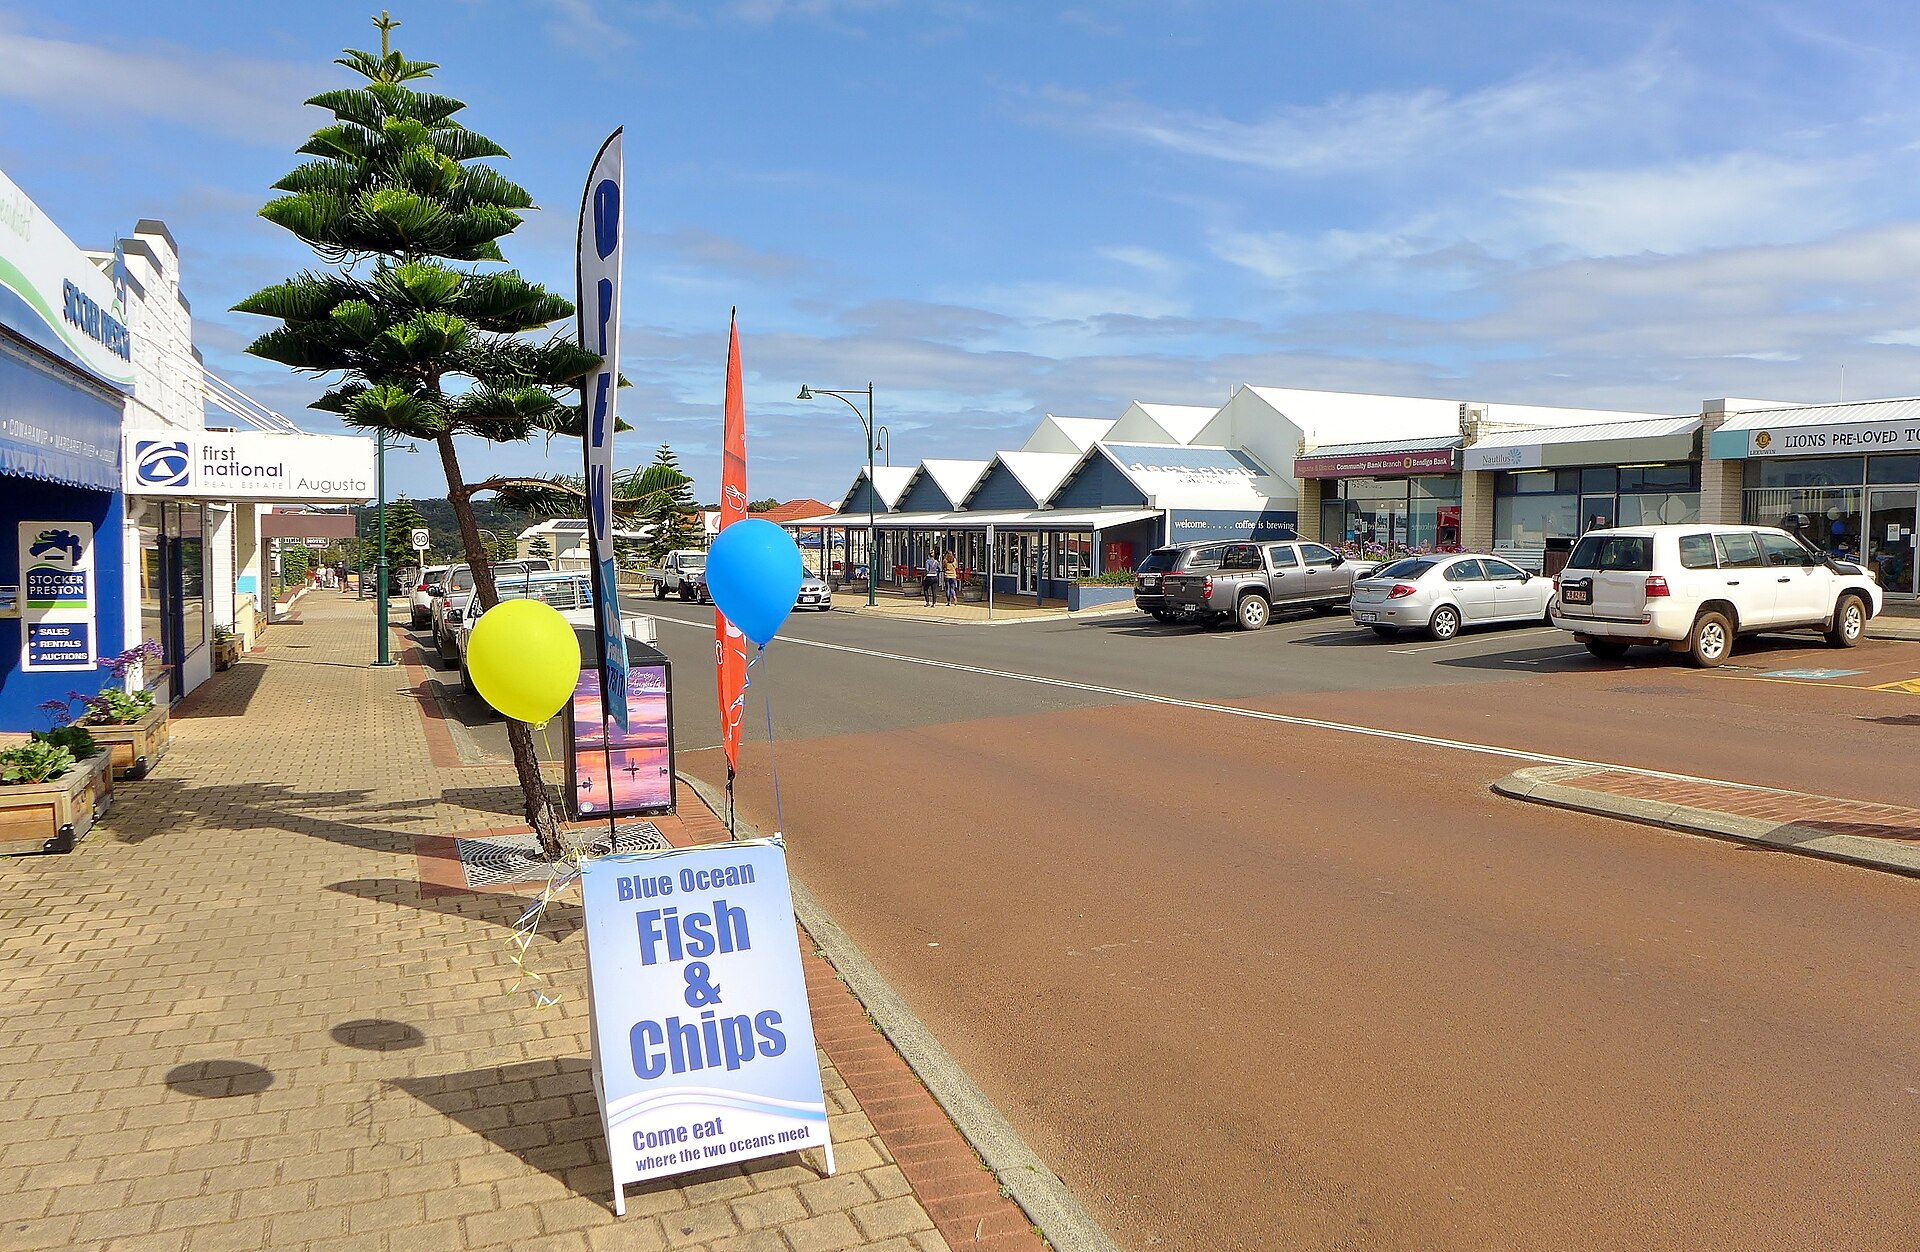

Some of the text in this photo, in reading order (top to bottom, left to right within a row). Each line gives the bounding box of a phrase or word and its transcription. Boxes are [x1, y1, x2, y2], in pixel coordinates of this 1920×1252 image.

[591, 178, 620, 541] OPEN
[1784, 434, 1826, 448] LIONS
[1832, 430, 1898, 446] PRE-LOVED
[203, 446, 236, 461] first
[1482, 454, 1511, 463] Nautilus
[1336, 462, 1367, 472] Community
[1367, 461, 1383, 469] Bank
[1382, 459, 1402, 468] Branch
[1412, 456, 1448, 467] Bendigo Bank
[203, 462, 283, 477] national
[204, 481, 284, 490] REAL ESTATE
[297, 477, 366, 494] Augusta
[1235, 519, 1256, 529] coffee
[1258, 520, 1264, 529] is
[1266, 520, 1295, 531] brewing
[415, 535, 426, 543] 50
[29, 575, 84, 585] STOCKER
[29, 585, 84, 595] PRESTON
[39, 628, 70, 636] SALES
[39, 640, 82, 648] RENTALS
[40, 652, 88, 661] AUCTIONS
[616, 863, 755, 902] Blue Ocean
[636, 899, 752, 967] Fish
[683, 962, 723, 1009] &
[628, 1008, 787, 1081] Chips
[632, 1116, 725, 1152] Come eat
[635, 1125, 811, 1173] where the two oceans meet
